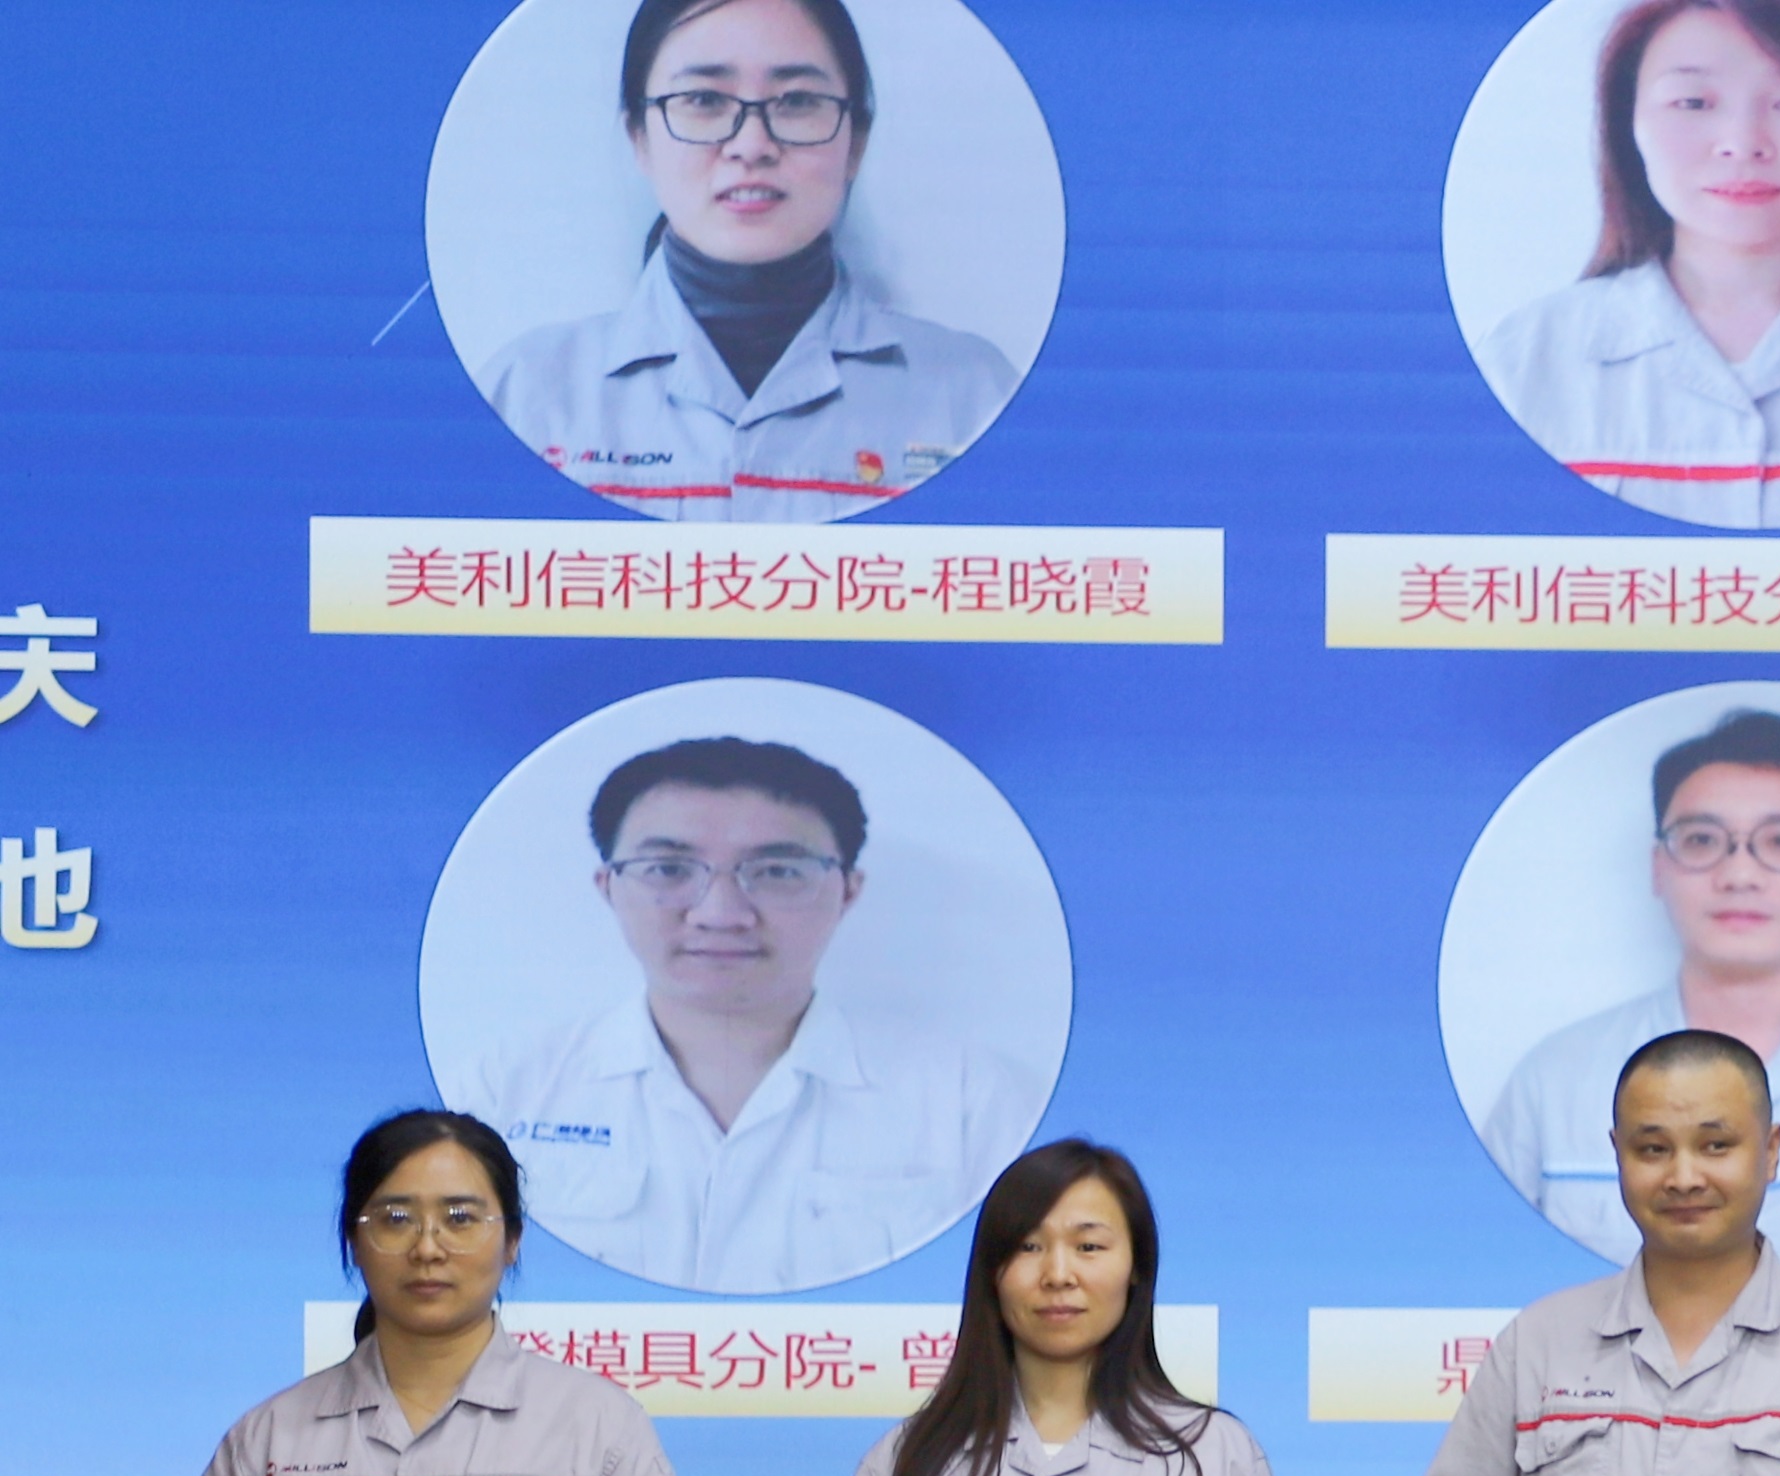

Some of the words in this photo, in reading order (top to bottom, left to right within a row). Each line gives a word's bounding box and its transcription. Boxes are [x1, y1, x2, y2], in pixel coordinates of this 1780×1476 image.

[386, 546, 1150, 617] 美利信科技分院-程晓霞
